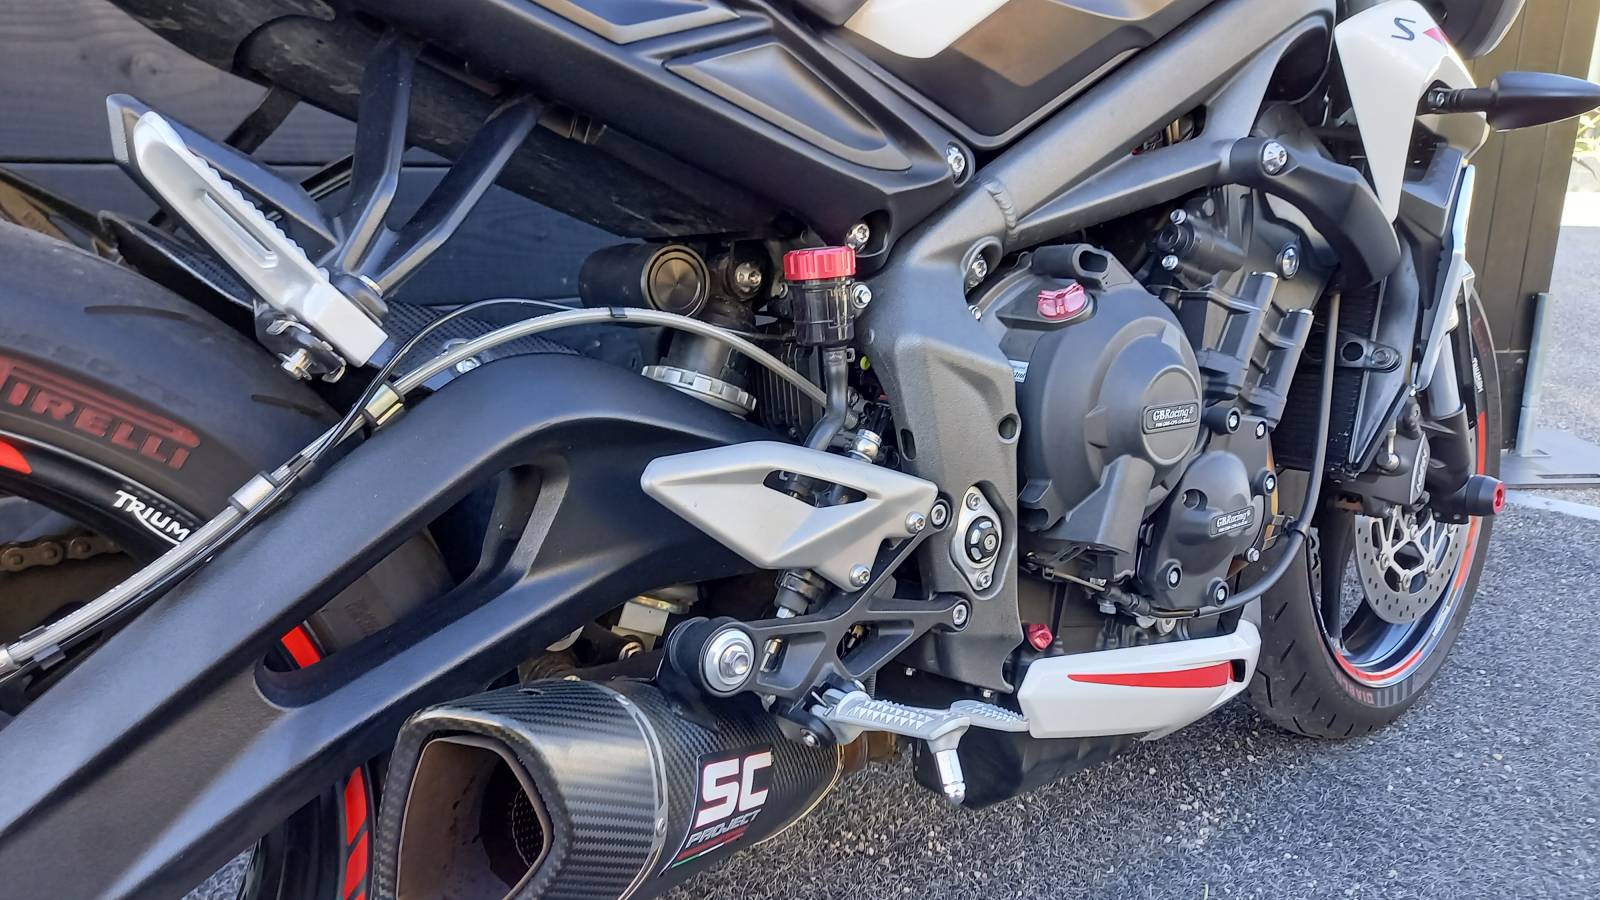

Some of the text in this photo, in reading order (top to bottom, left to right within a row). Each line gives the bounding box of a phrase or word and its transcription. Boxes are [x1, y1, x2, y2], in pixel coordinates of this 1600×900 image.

[1391, 16, 1417, 42] S
[695, 751, 772, 829] SC
[685, 808, 762, 849] PROJECT
